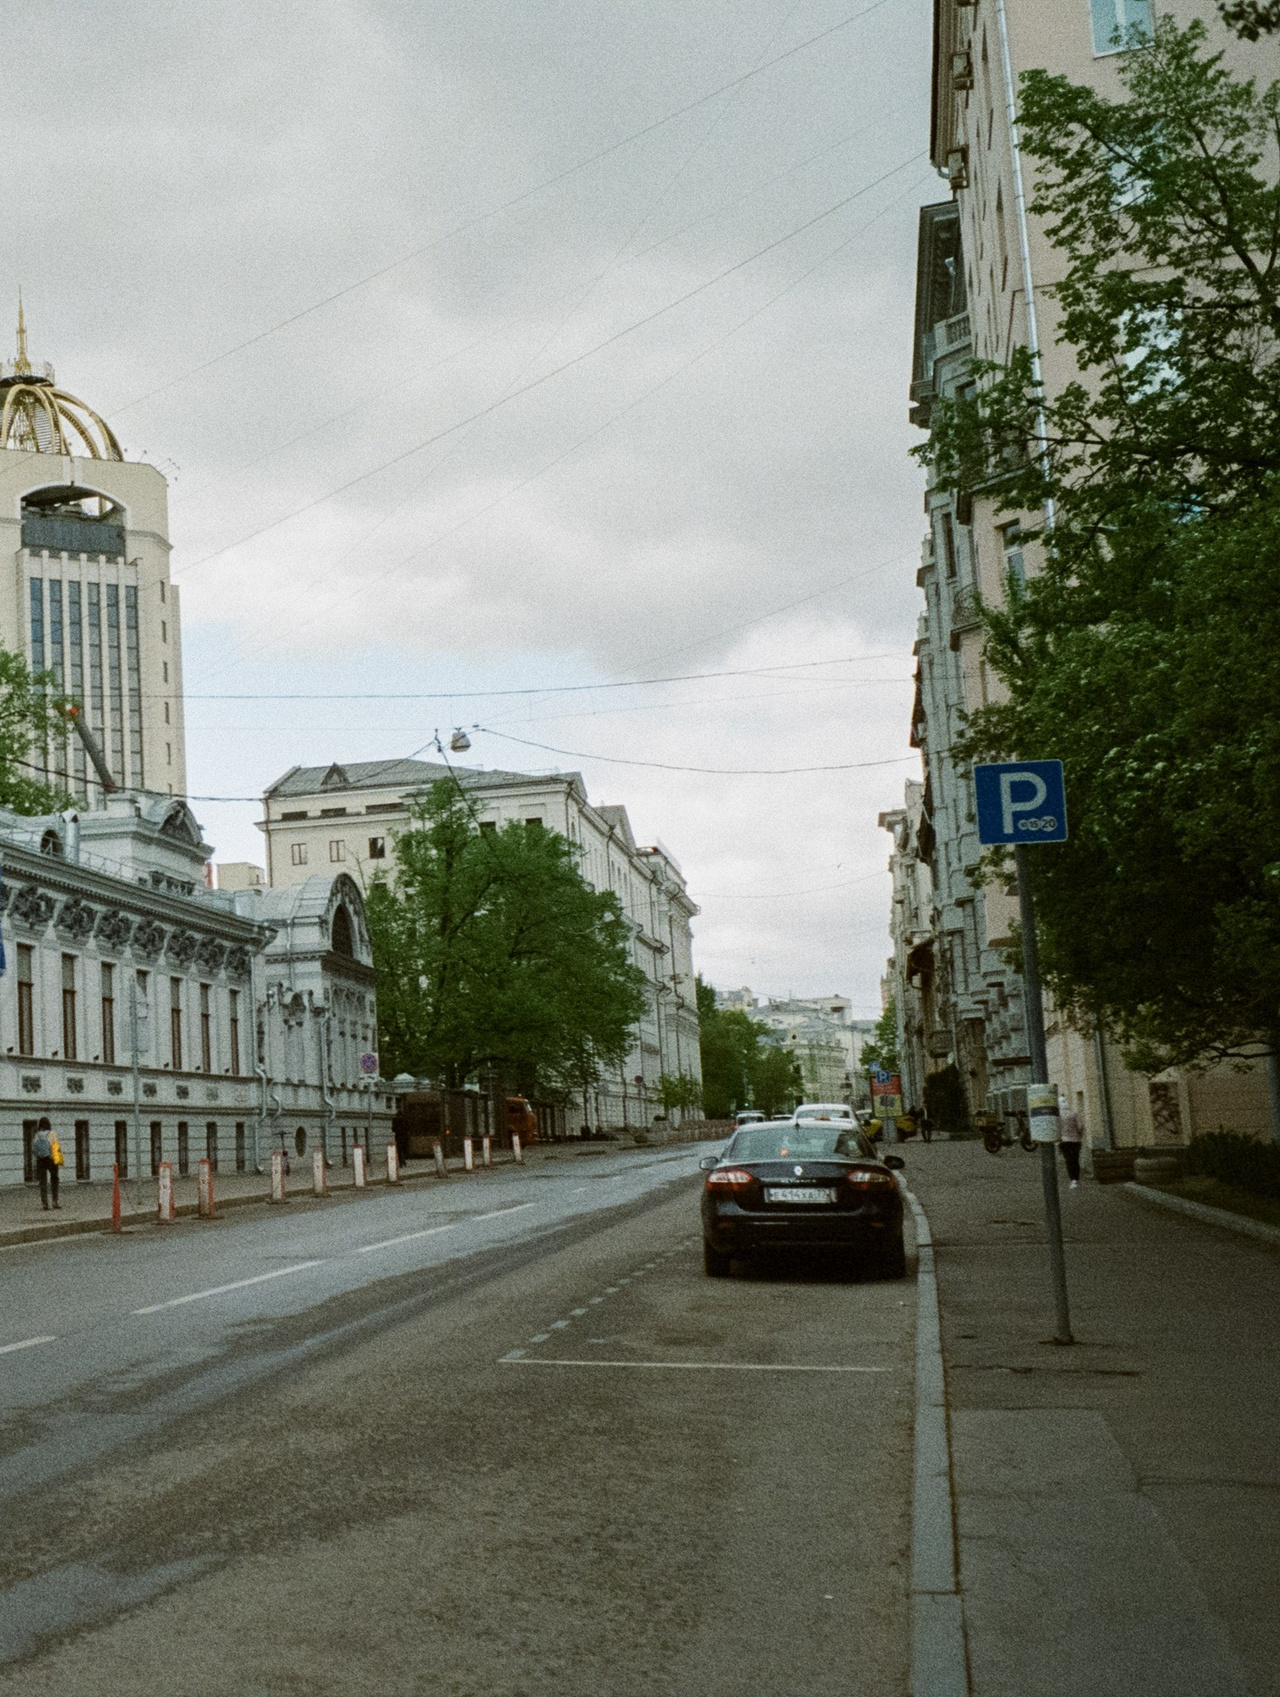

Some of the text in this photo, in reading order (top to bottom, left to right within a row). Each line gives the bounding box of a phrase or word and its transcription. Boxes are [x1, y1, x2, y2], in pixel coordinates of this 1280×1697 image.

[1000, 772, 1047, 834] P
[1042, 818, 1056, 828] 20
[879, 1071, 887, 1081] P
